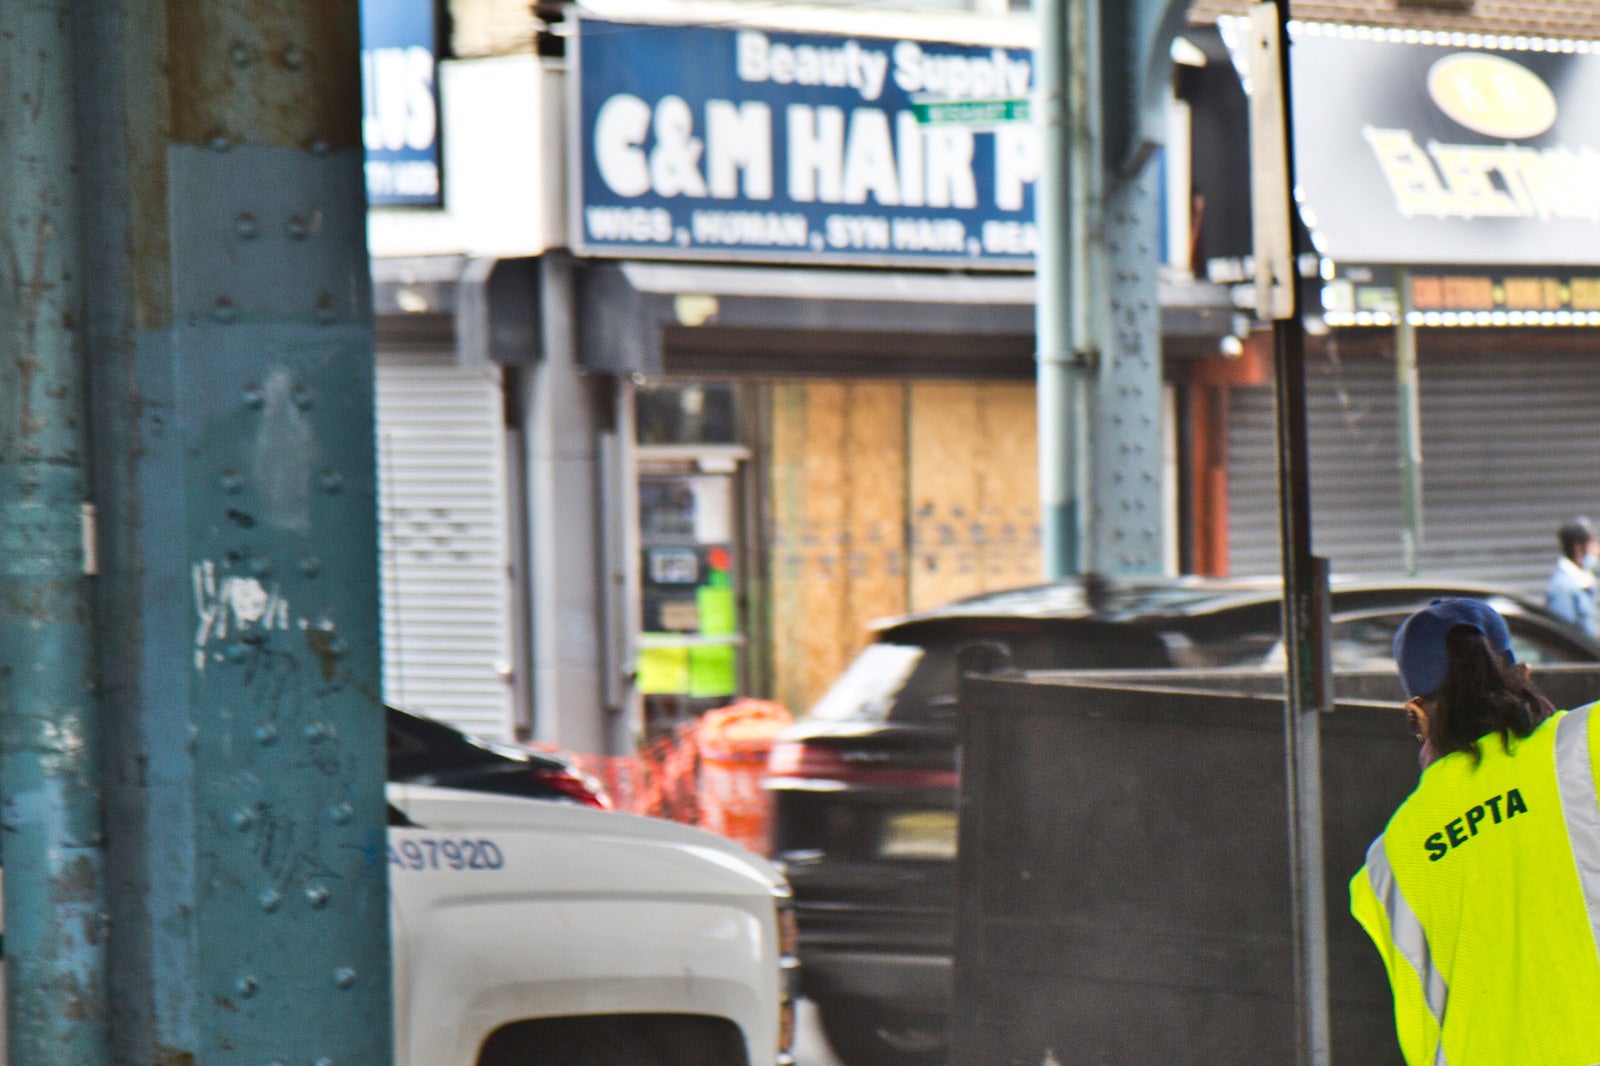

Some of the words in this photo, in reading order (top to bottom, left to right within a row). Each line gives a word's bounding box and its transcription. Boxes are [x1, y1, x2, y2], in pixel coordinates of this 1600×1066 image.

[738, 29, 888, 100] Beauty
[893, 40, 1032, 98] Supply
[594, 93, 774, 199] C&M
[787, 104, 976, 209] HAIR
[826, 209, 889, 249] SYN
[1424, 788, 1528, 862] SEPTA
